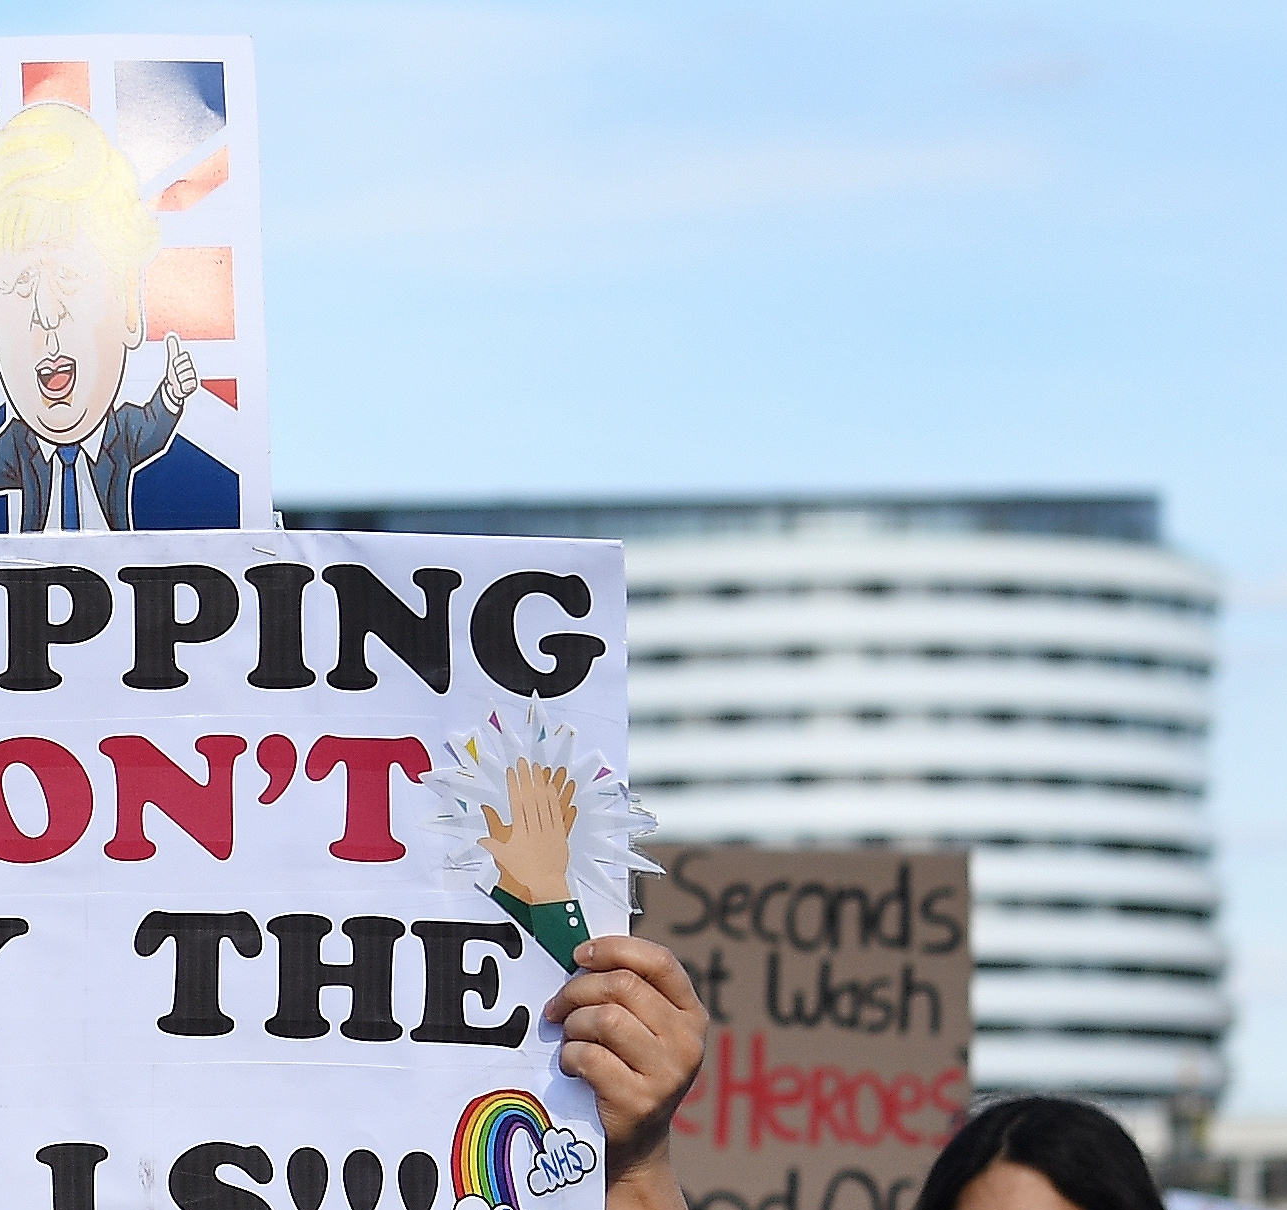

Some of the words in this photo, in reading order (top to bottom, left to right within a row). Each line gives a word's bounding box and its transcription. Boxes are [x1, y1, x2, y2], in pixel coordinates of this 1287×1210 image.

[671, 850, 963, 952] Seconds
[134, 910, 529, 1048] THE
[767, 952, 942, 1034] Wash
[540, 1142, 582, 1183] NHS
